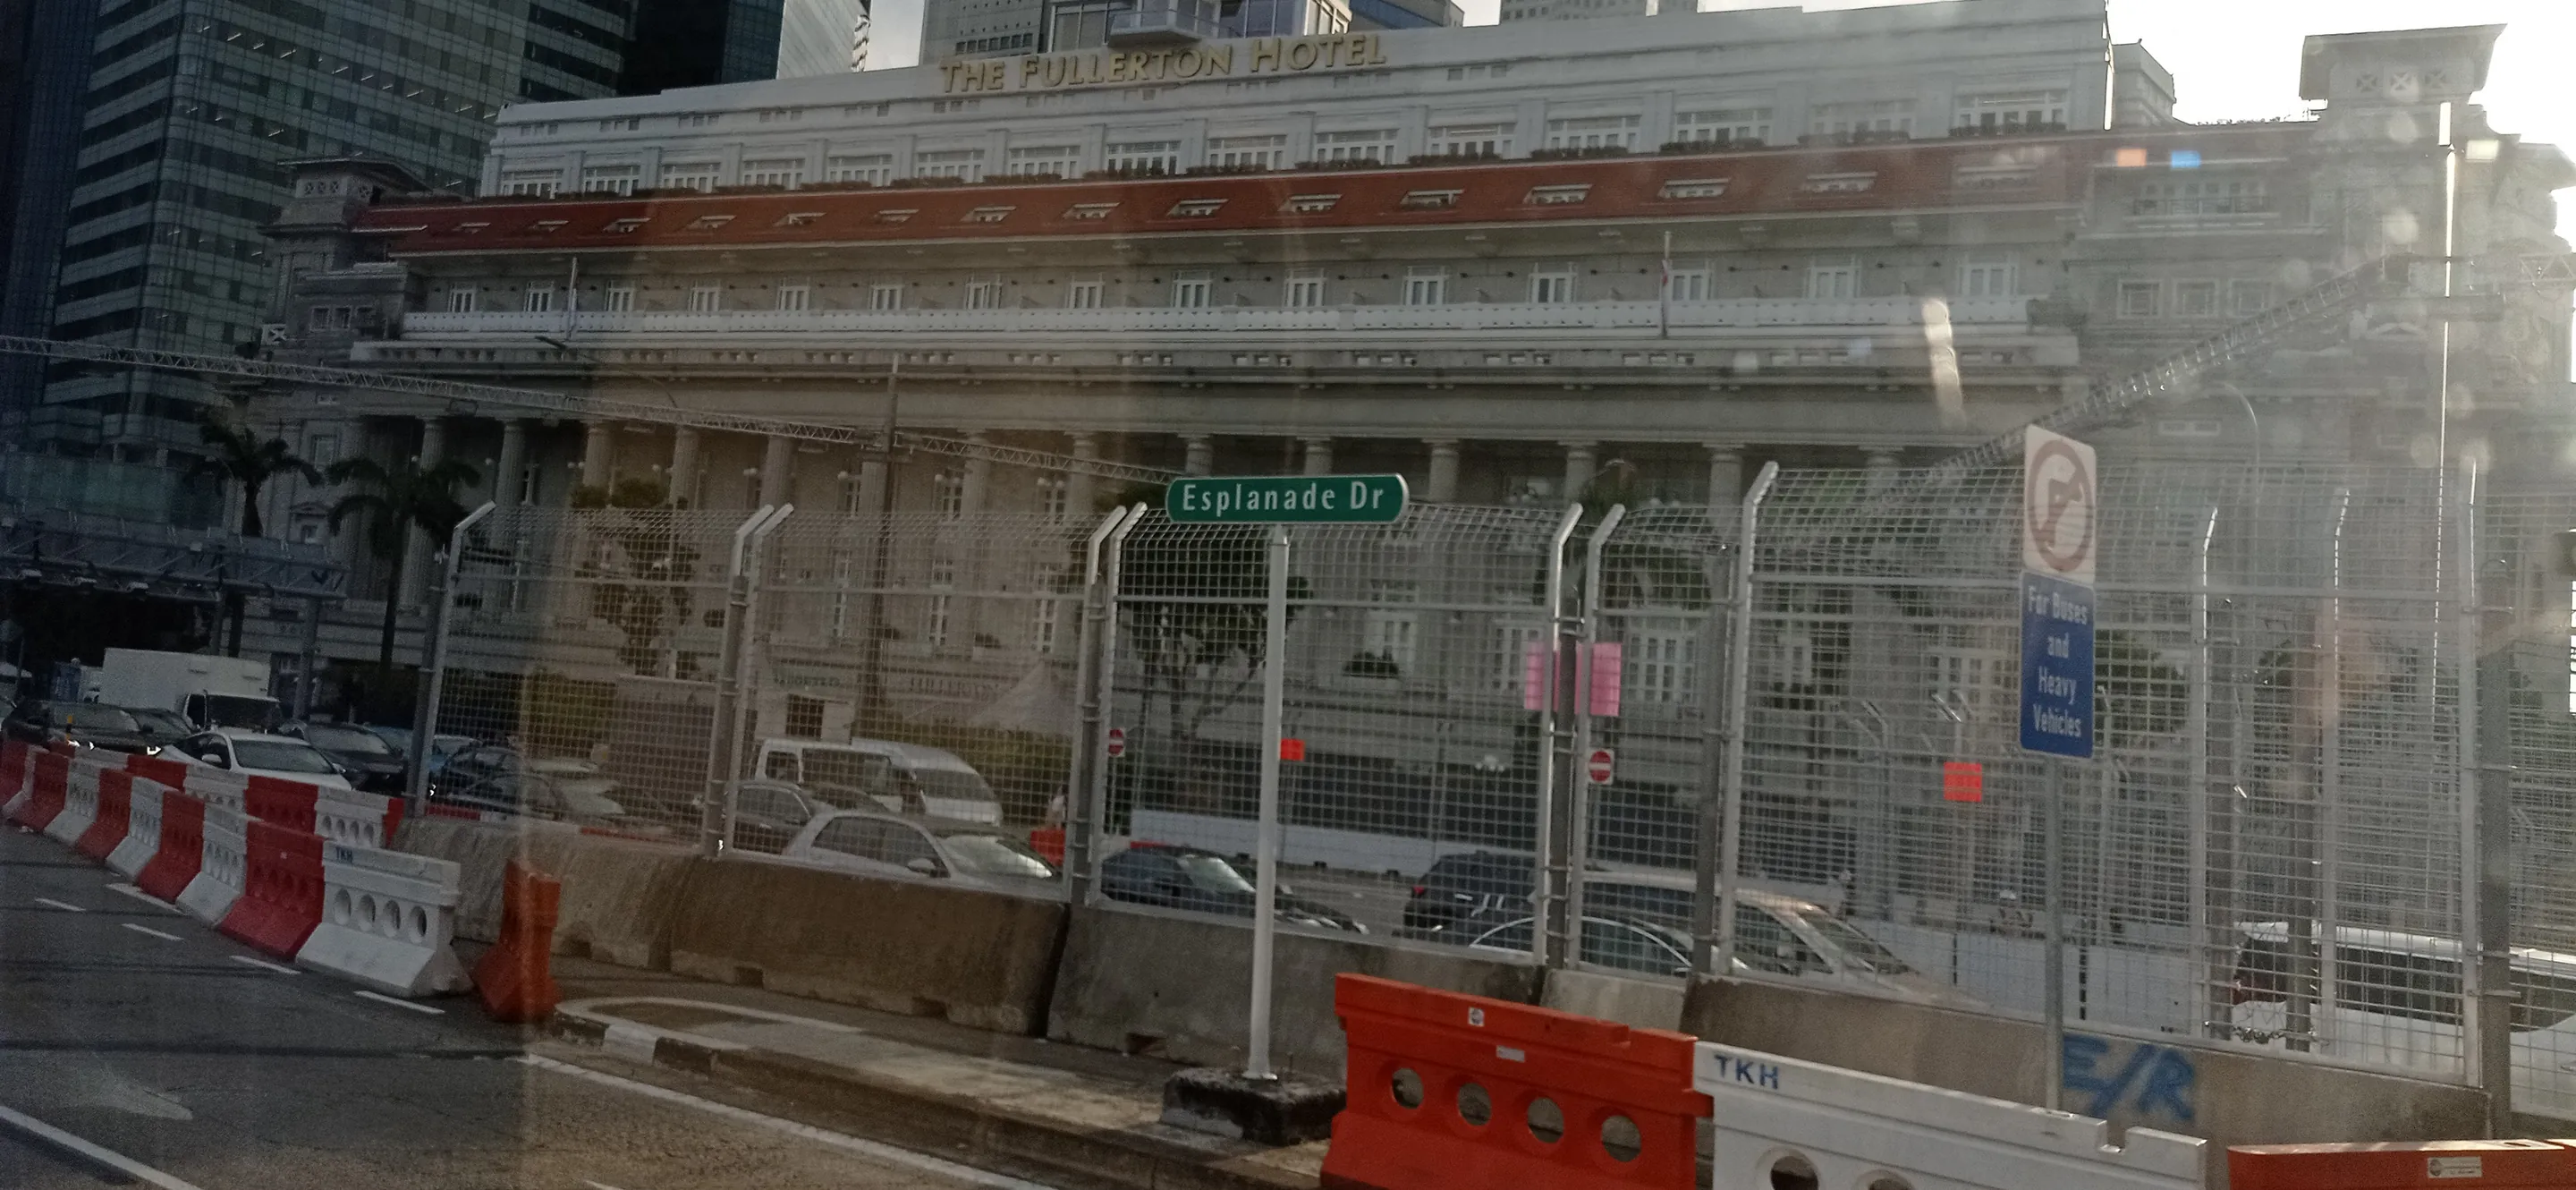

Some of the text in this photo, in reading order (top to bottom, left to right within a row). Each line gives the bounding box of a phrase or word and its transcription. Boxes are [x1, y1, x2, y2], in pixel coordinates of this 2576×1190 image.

[940, 33, 1388, 94] THE FULLERTON HOTEL
[1182, 480, 1385, 517] Esplanade Dr
[2028, 584, 2089, 625] For Buses
[2046, 632, 2071, 659] and
[2038, 665, 2078, 706] Heavy
[2032, 702, 2082, 737] Vehicles
[335, 845, 354, 865] TKH
[1714, 1054, 1779, 1090] TKH
